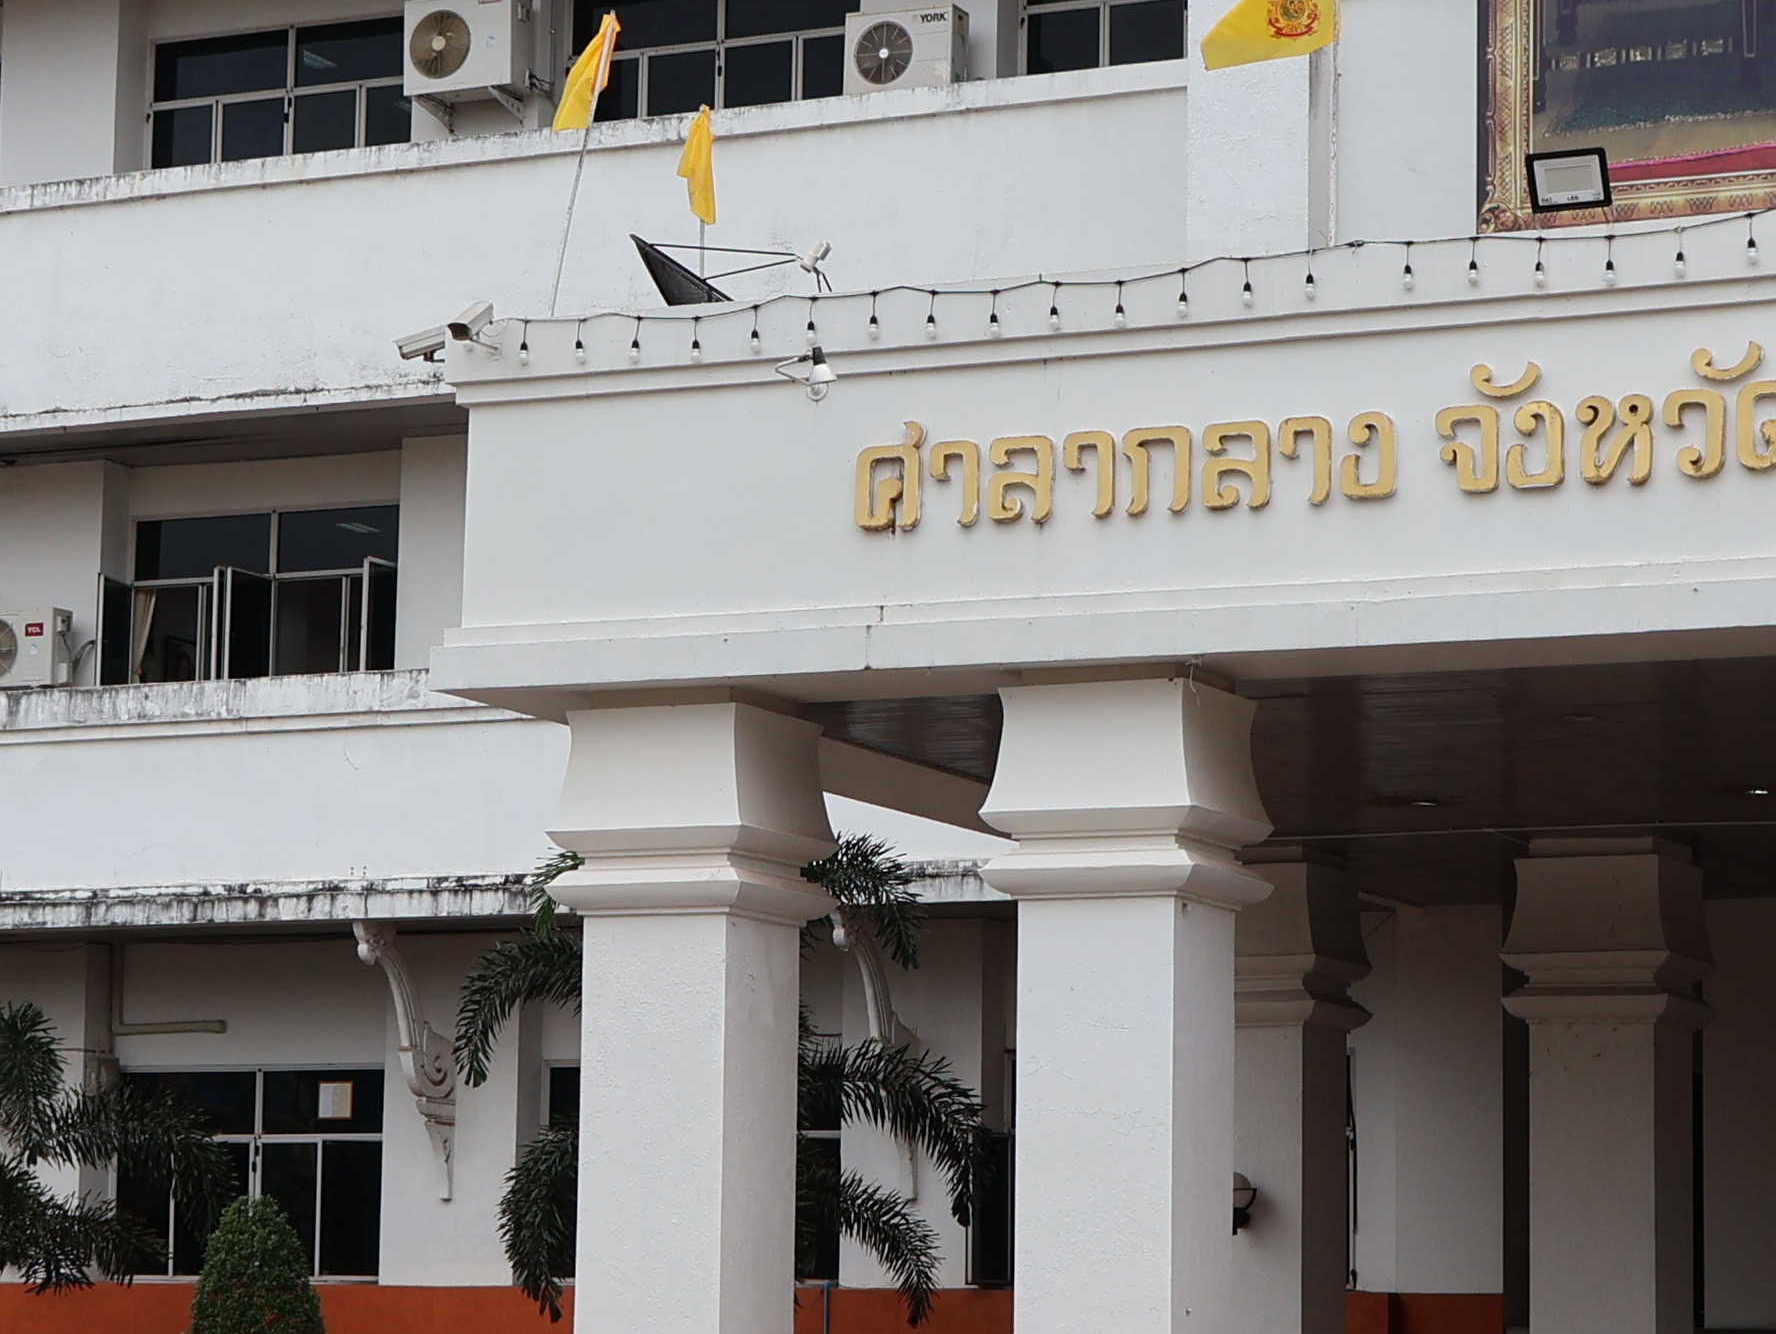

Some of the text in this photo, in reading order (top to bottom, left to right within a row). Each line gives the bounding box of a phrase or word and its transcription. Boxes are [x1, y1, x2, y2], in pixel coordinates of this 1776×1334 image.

[920, 12, 948, 23] YORK
[854, 410, 1397, 532] ศาลากลาง
[27, 626, 42, 634] TCL
